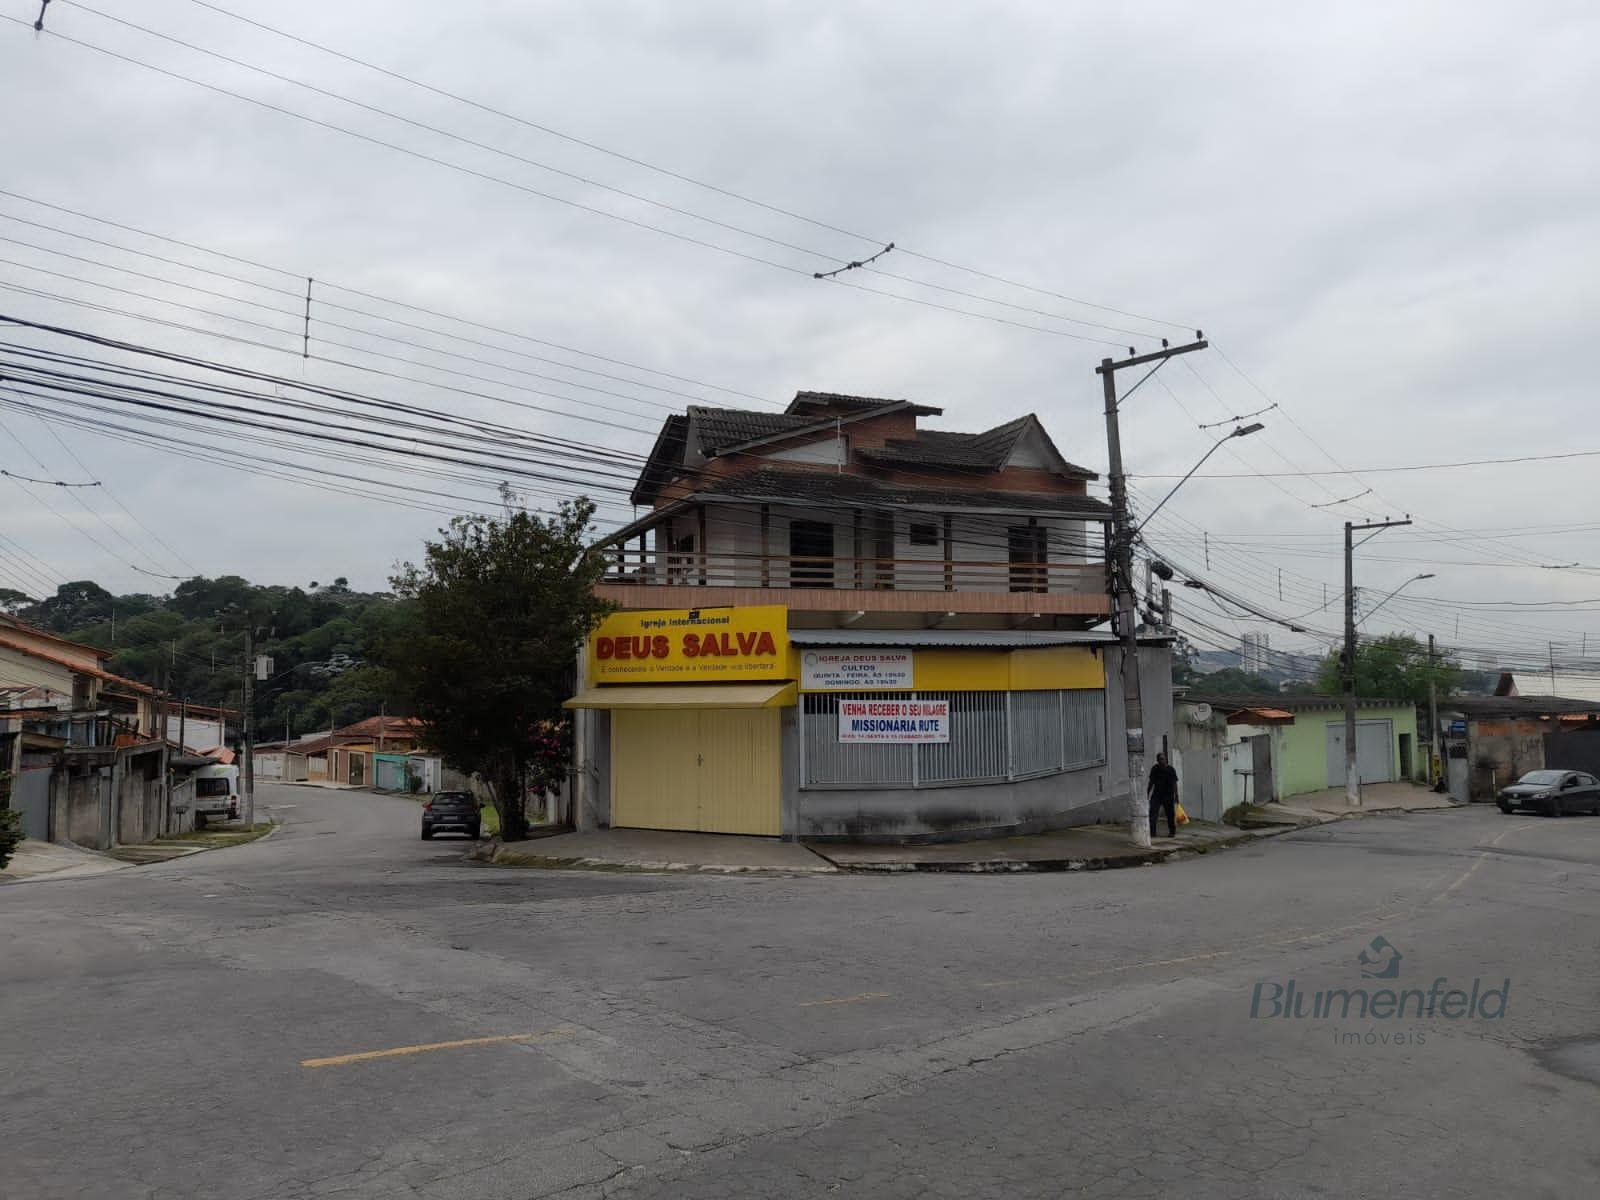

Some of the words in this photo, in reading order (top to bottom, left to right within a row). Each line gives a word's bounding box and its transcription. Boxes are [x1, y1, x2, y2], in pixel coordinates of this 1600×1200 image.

[640, 619, 667, 629] Igreja
[669, 616, 730, 626] Internacional
[597, 635, 670, 660] DEUS
[683, 632, 777, 657] SALVA
[841, 664, 876, 672] CULTOS
[842, 703, 867, 716] VENHA
[869, 703, 899, 716] RECEBER
[902, 703, 908, 716] O
[909, 703, 922, 716] SEU
[922, 703, 947, 716] MILAGRE
[918, 719, 940, 732] RUTE
